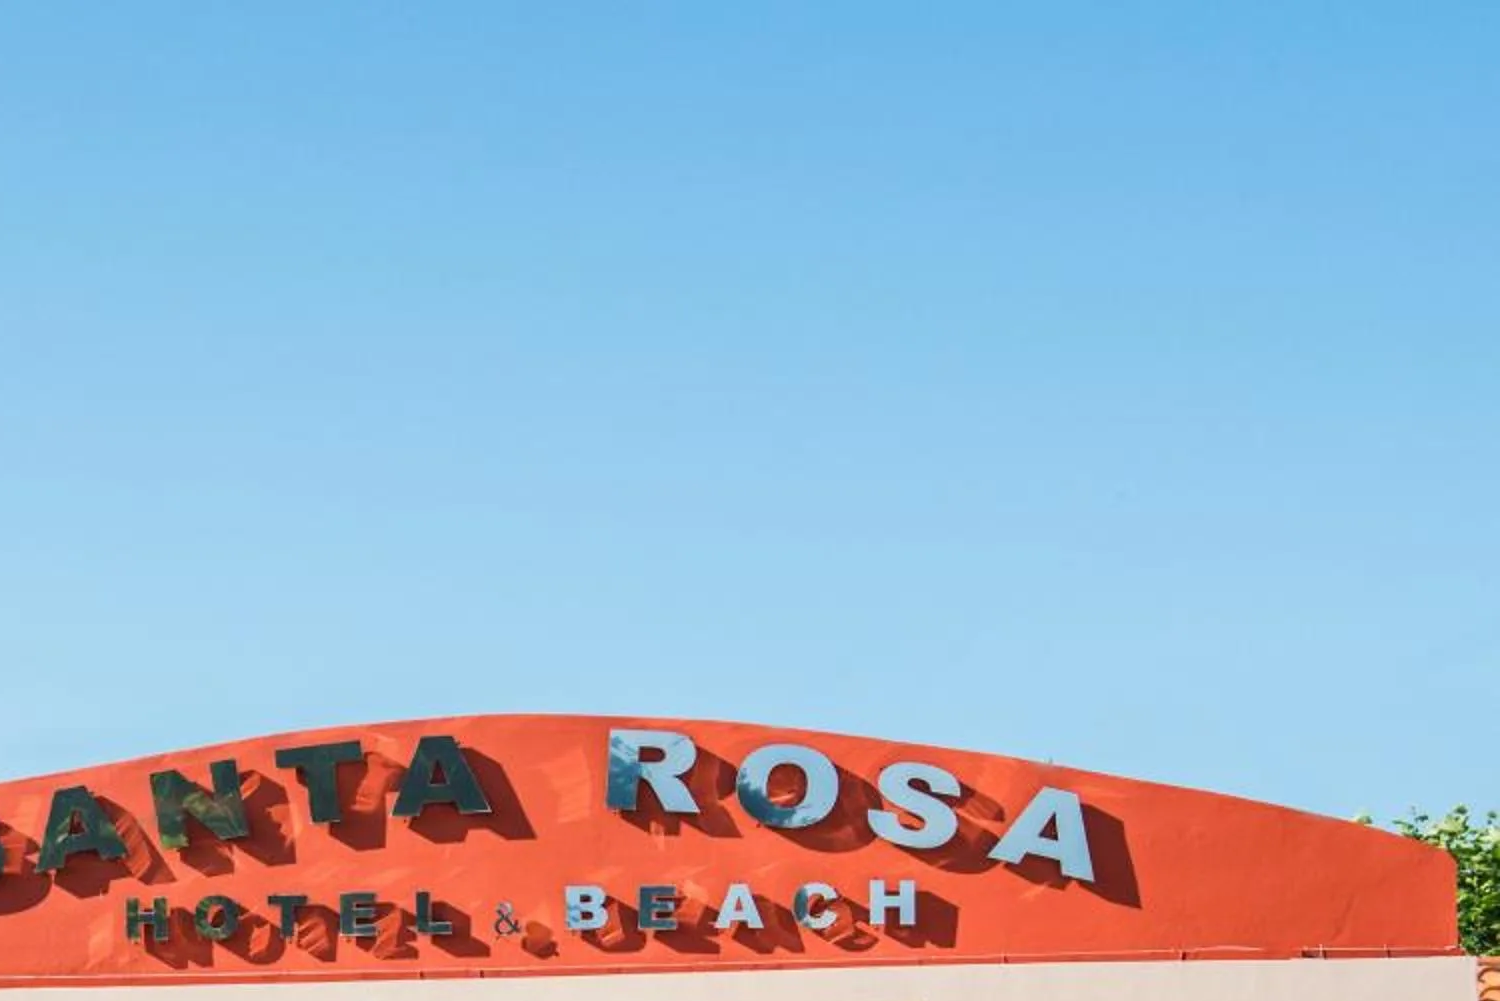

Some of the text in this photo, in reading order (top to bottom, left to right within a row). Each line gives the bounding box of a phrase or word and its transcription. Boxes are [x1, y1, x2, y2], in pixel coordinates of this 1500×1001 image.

[605, 728, 1096, 883] ROSA
[125, 879, 917, 944] HOTEL & BEACH
